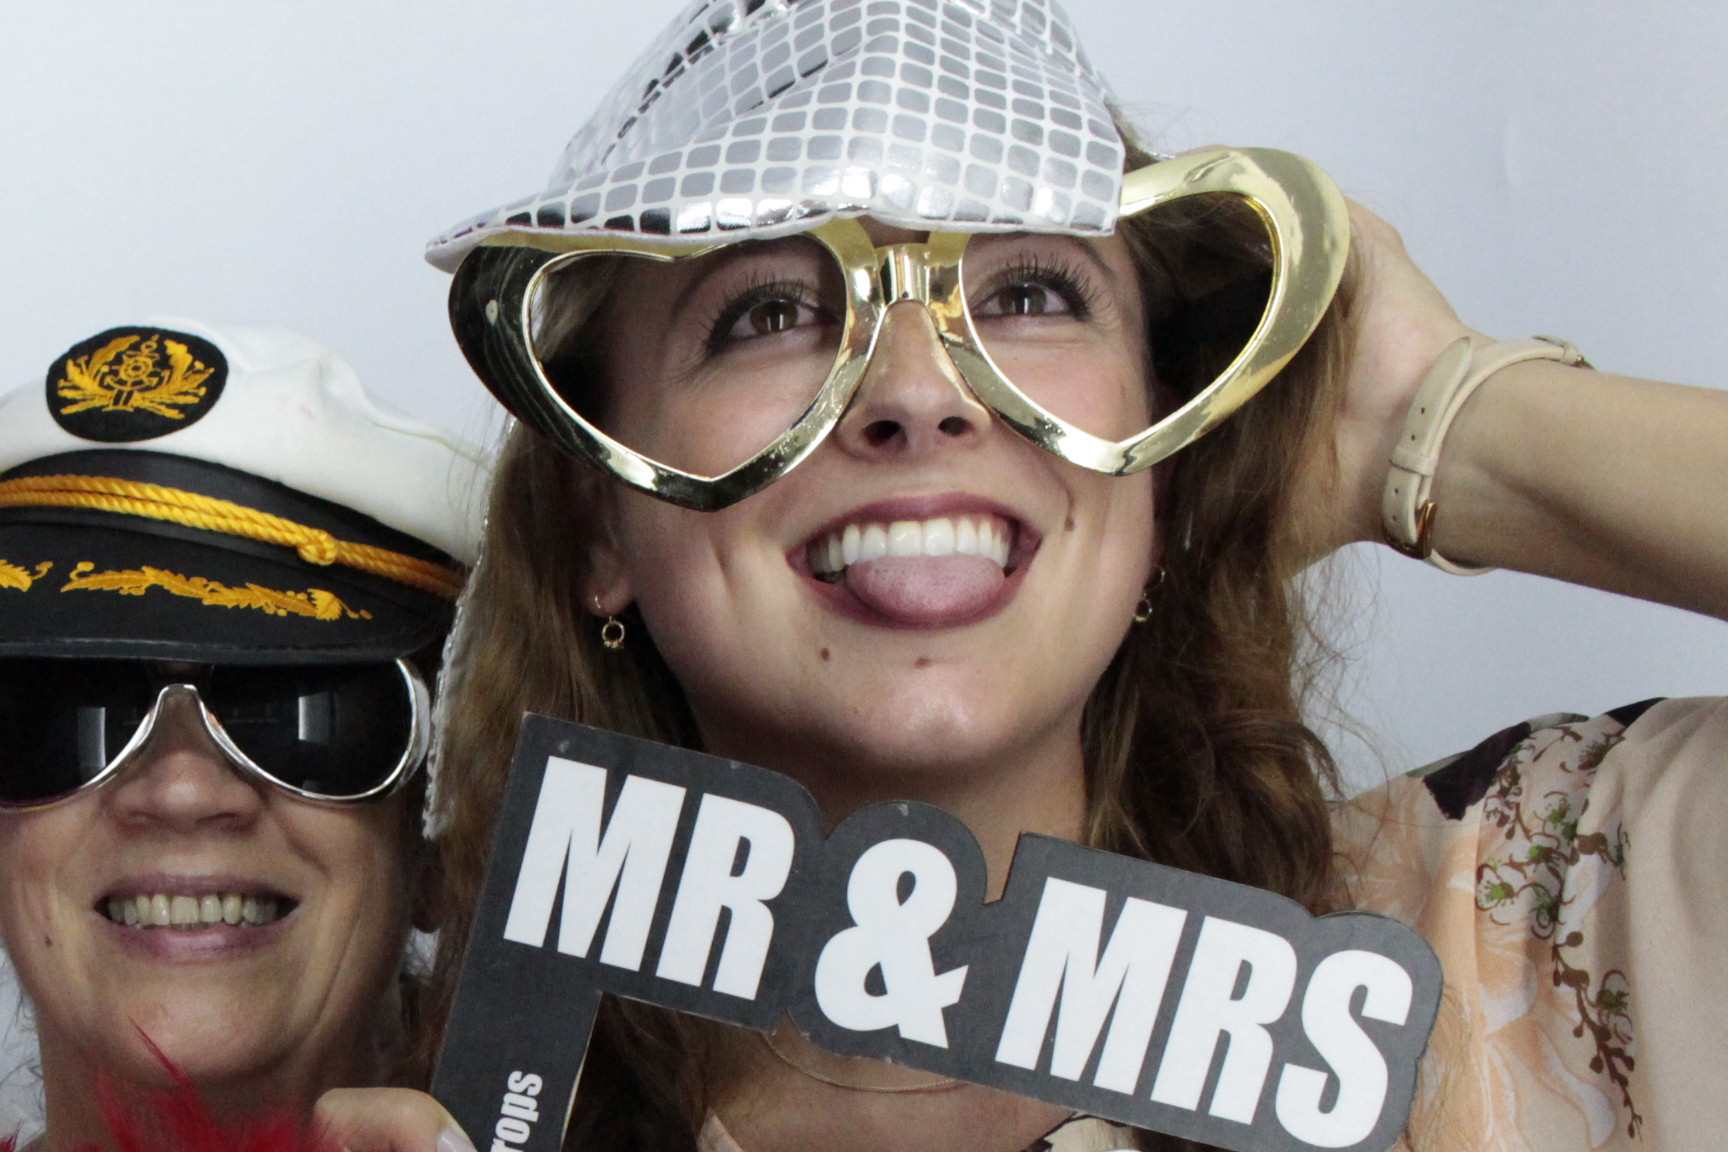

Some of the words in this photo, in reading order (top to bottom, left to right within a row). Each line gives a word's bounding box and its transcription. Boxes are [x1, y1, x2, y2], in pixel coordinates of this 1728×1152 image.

[503, 755, 796, 1001] MR
[814, 838, 969, 1049] &
[994, 876, 1414, 1149] MRS
